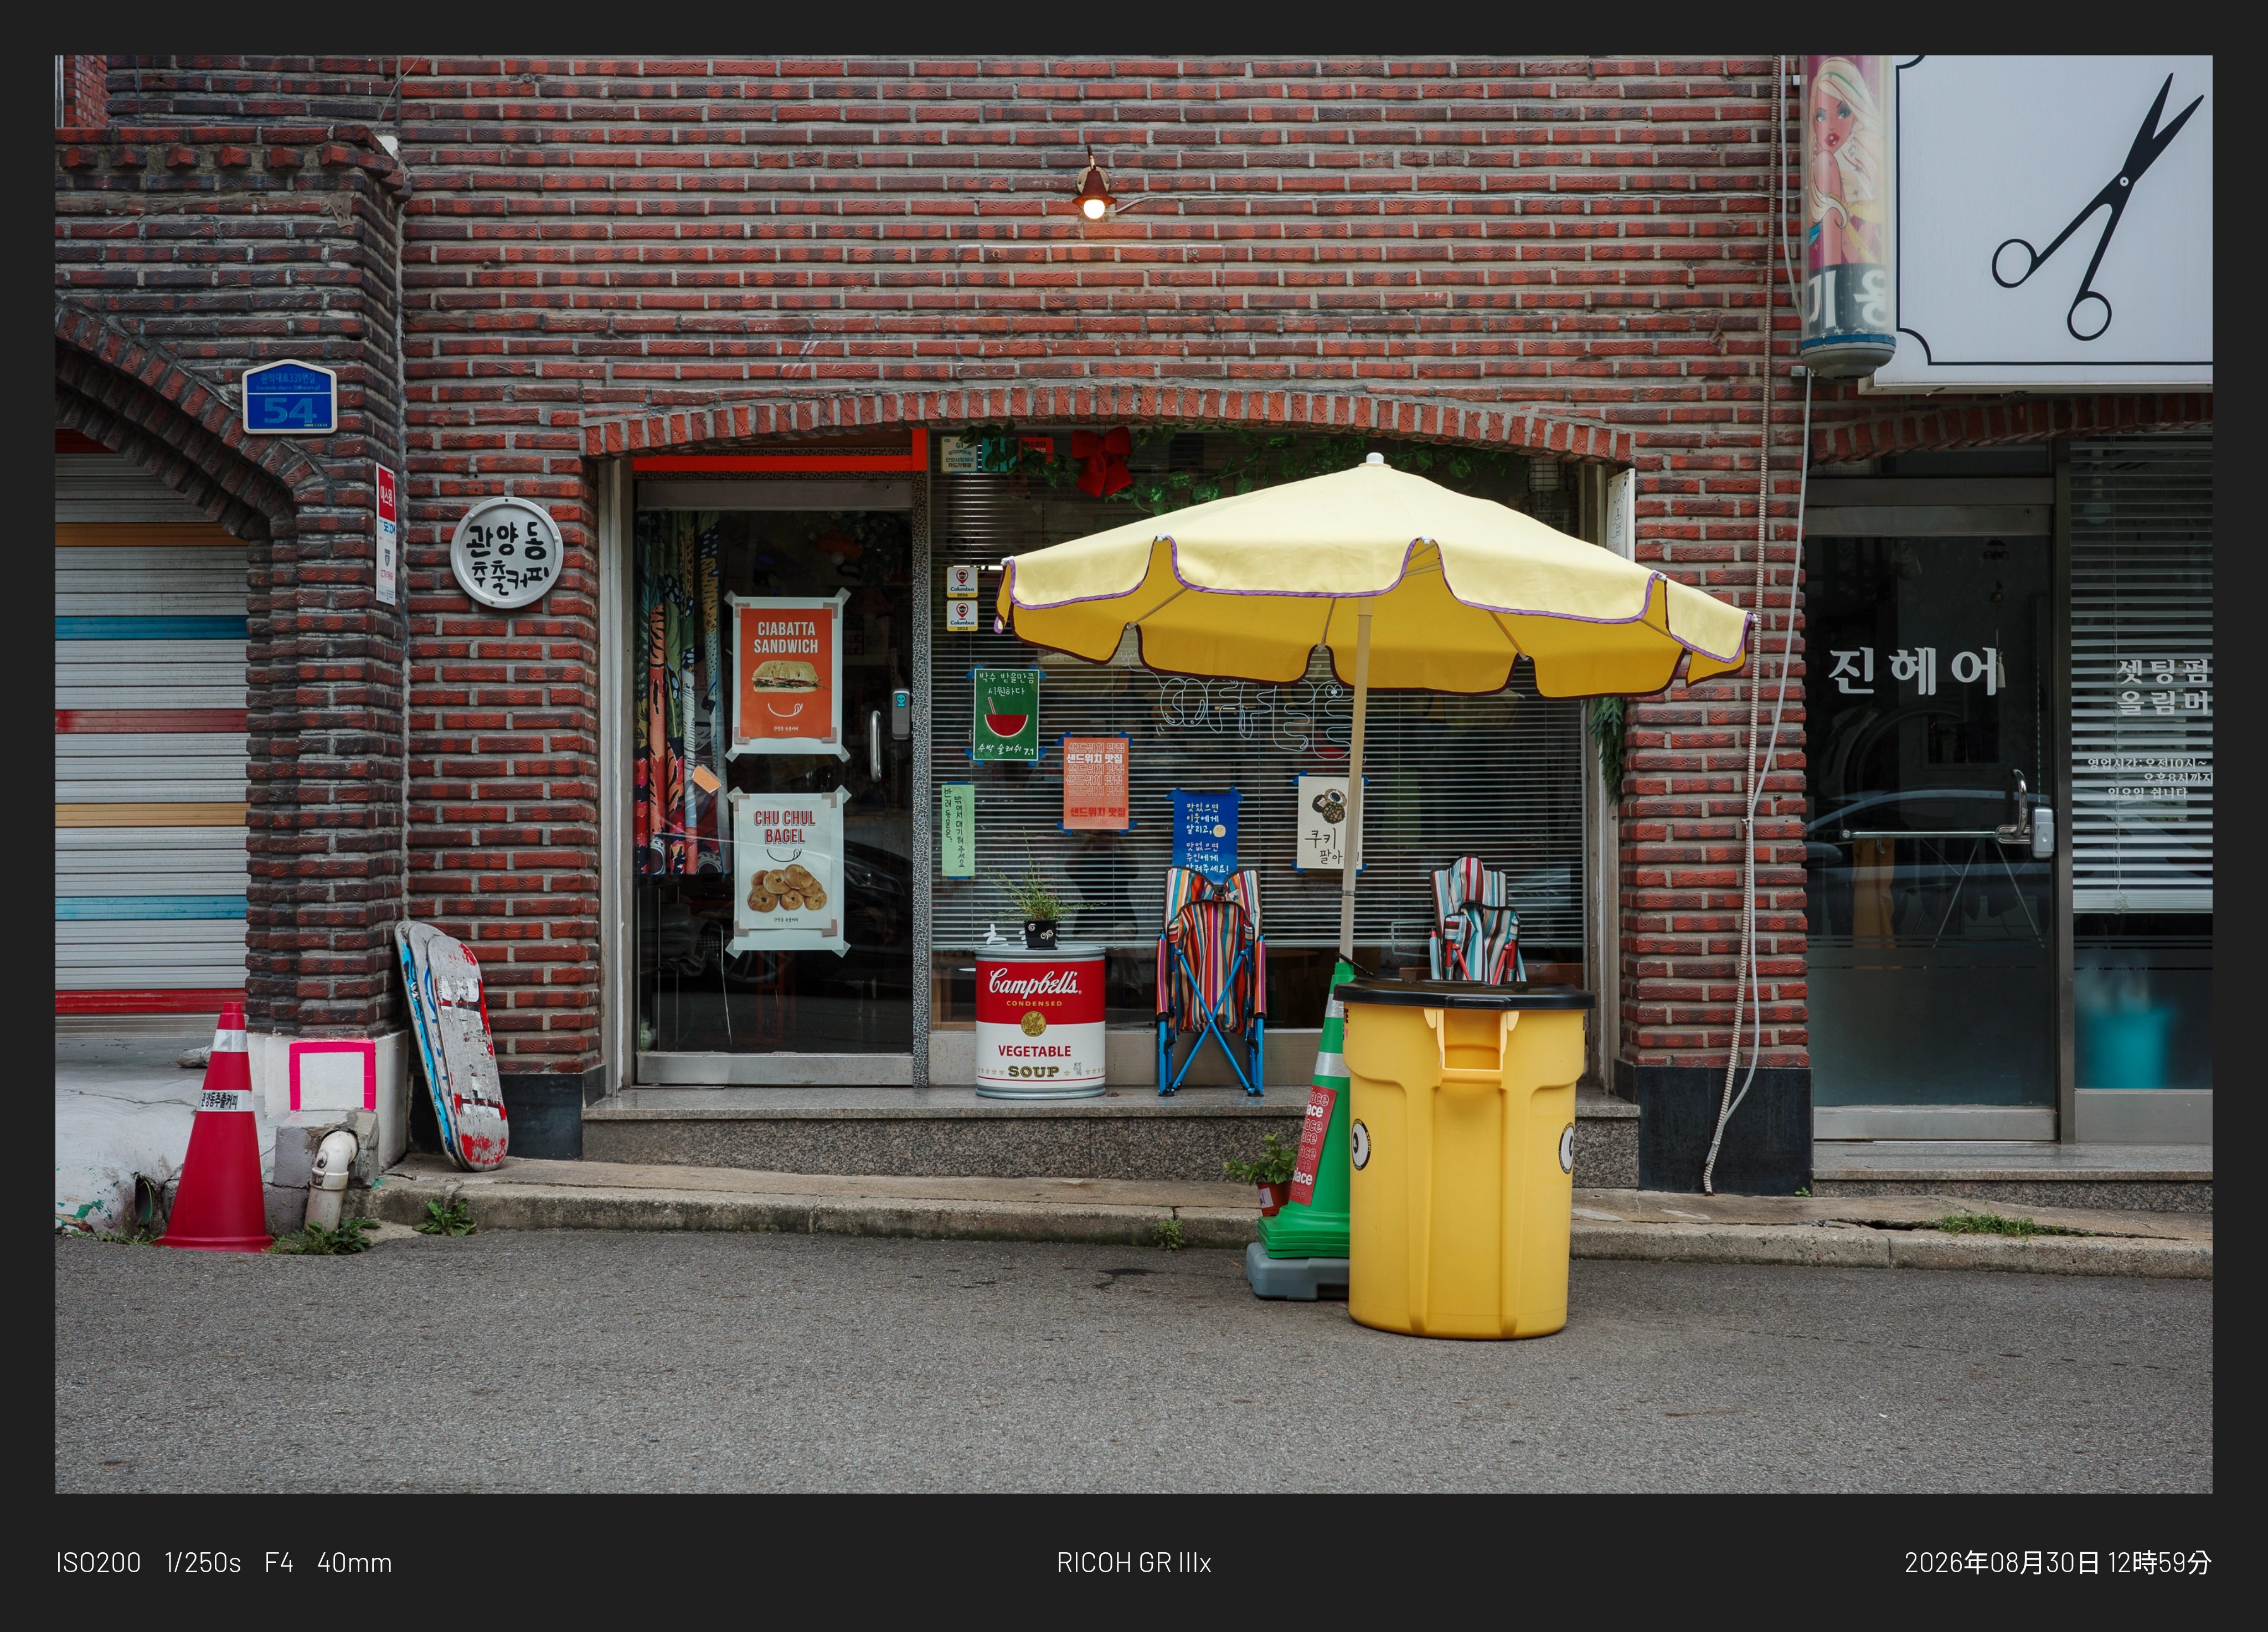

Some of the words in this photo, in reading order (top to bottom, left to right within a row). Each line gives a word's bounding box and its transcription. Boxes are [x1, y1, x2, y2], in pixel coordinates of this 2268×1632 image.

[261, 373, 315, 384] 관악대로339번길
[264, 398, 317, 423] 54
[466, 522, 547, 559] 관양동
[472, 561, 549, 595] 추출커피
[757, 622, 816, 636] CIABATTA
[754, 639, 818, 653] SANDWICH
[980, 672, 996, 682] 박수
[1001, 672, 1034, 683] 받을만큼
[1828, 647, 1997, 696] 진헤어
[2117, 659, 2208, 684] 셋팅펌
[988, 687, 1025, 697] 시원하다
[2117, 690, 2208, 715] 올림머
[978, 744, 994, 753] 수박
[997, 744, 1022, 755] 슬러쉬
[1068, 743, 1104, 753] 샌드위치
[1106, 743, 1125, 753] 맛집
[1066, 754, 1102, 764] 샌드위치
[1105, 754, 1122, 764] 맛집
[1068, 764, 1104, 775] 샌드위치
[1106, 764, 1125, 775] 맛집
[1066, 775, 1102, 785] 샌드위치
[1105, 775, 1122, 785] 맛집
[2143, 772, 2213, 784] 오후8시까지
[1068, 786, 1104, 796] 샌드위치
[1106, 786, 1125, 796] 맛집
[2108, 787, 2144, 800] 일요일
[2150, 787, 2188, 800] 쉽니다
[1066, 796, 1102, 807] 샌드위치
[1104, 796, 1122, 807] 맛집
[1187, 802, 1219, 812] 맛있으면
[1070, 807, 1105, 817] 샌드위치
[1109, 807, 1126, 817] 맛집
[1187, 813, 1219, 823] 이웃에게
[754, 811, 779, 826] CHU
[782, 811, 816, 826] CHUL
[1186, 824, 1212, 835] 알리고,
[765, 829, 806, 844] BAGEL
[1305, 827, 1337, 850] 쿠키
[1186, 842, 1219, 852] 맛없으면
[1187, 853, 1219, 862] 주인에게
[1319, 850, 1359, 866] 팔아!
[989, 967, 1079, 1000] Campbell's
[998, 1045, 1071, 1057] VEGETABLE
[1008, 1065, 1060, 1078] SOUP
